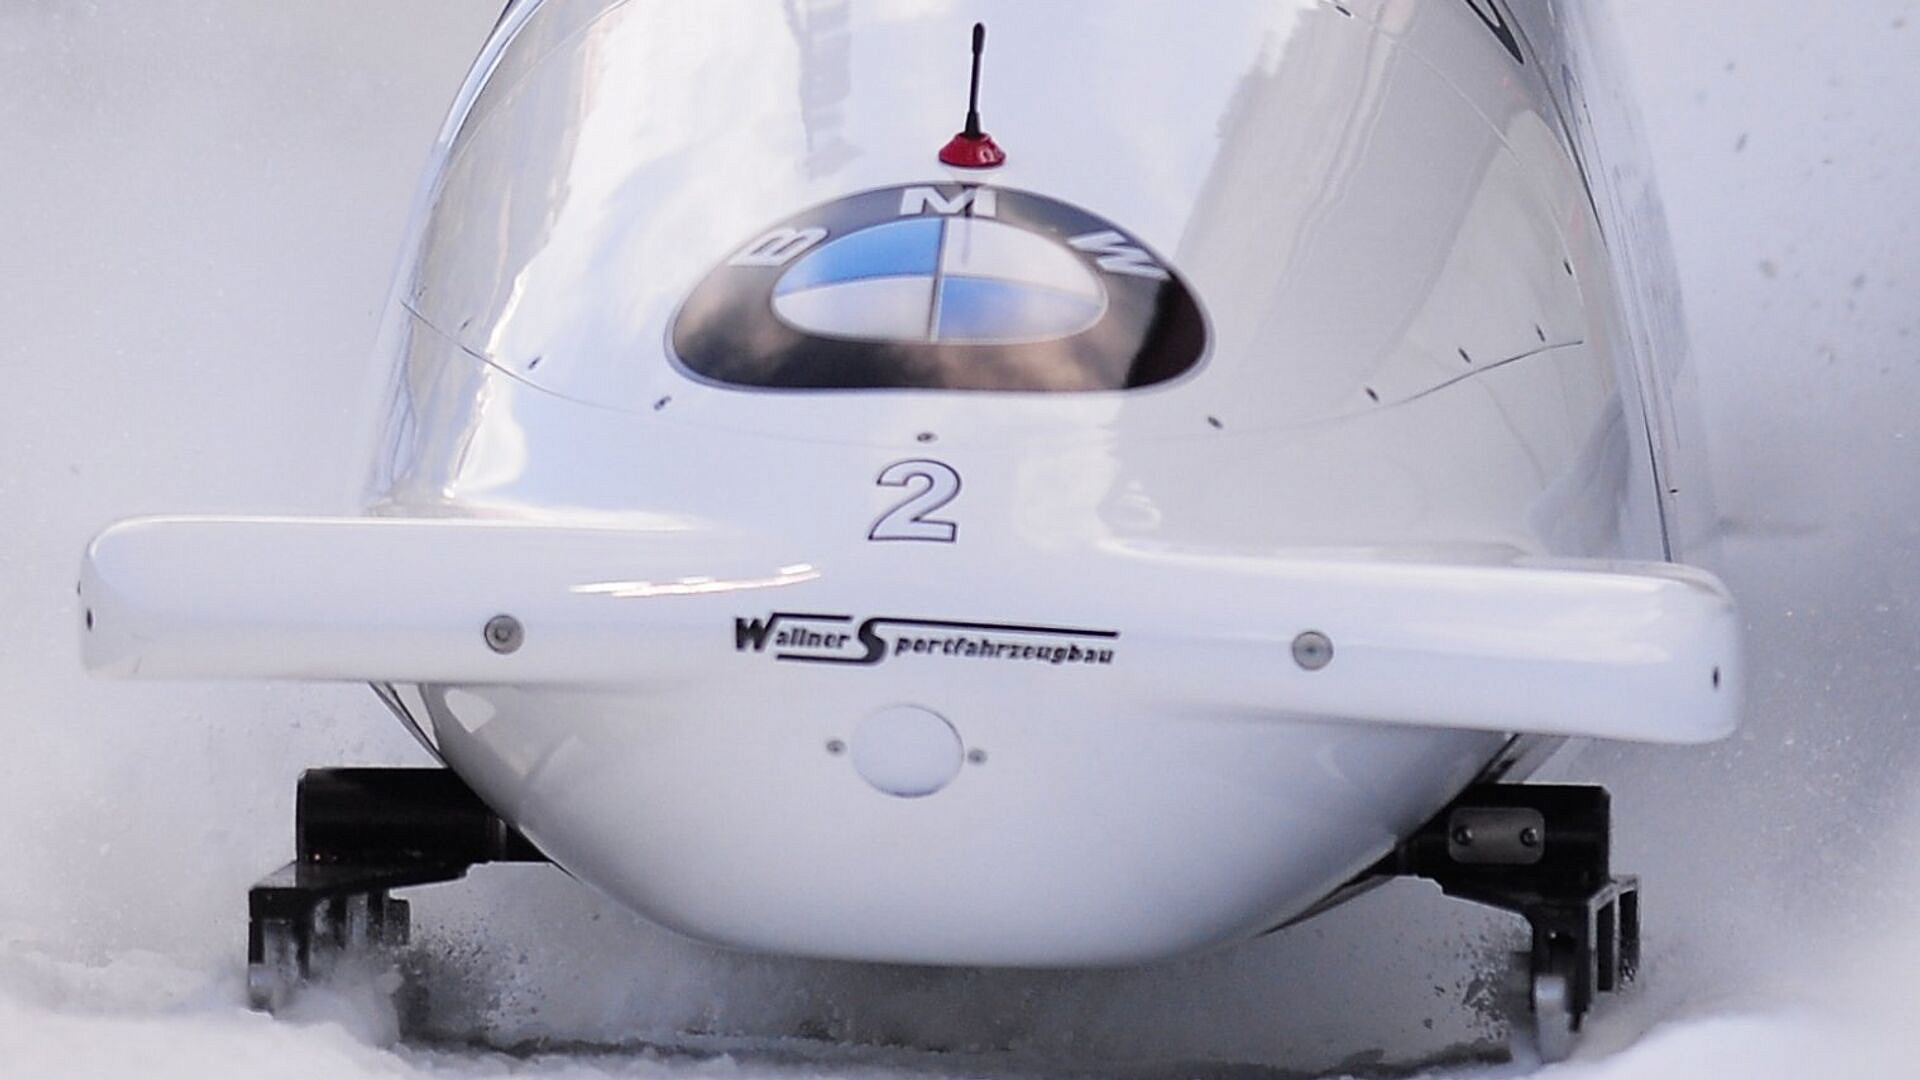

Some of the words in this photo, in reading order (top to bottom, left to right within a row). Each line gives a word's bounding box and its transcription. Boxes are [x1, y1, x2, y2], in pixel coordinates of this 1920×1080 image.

[728, 186, 1170, 280] BMW
[868, 459, 962, 543] 2
[735, 613, 850, 652] Wallner
[857, 617, 1116, 666] Sportfahrzeugbau
